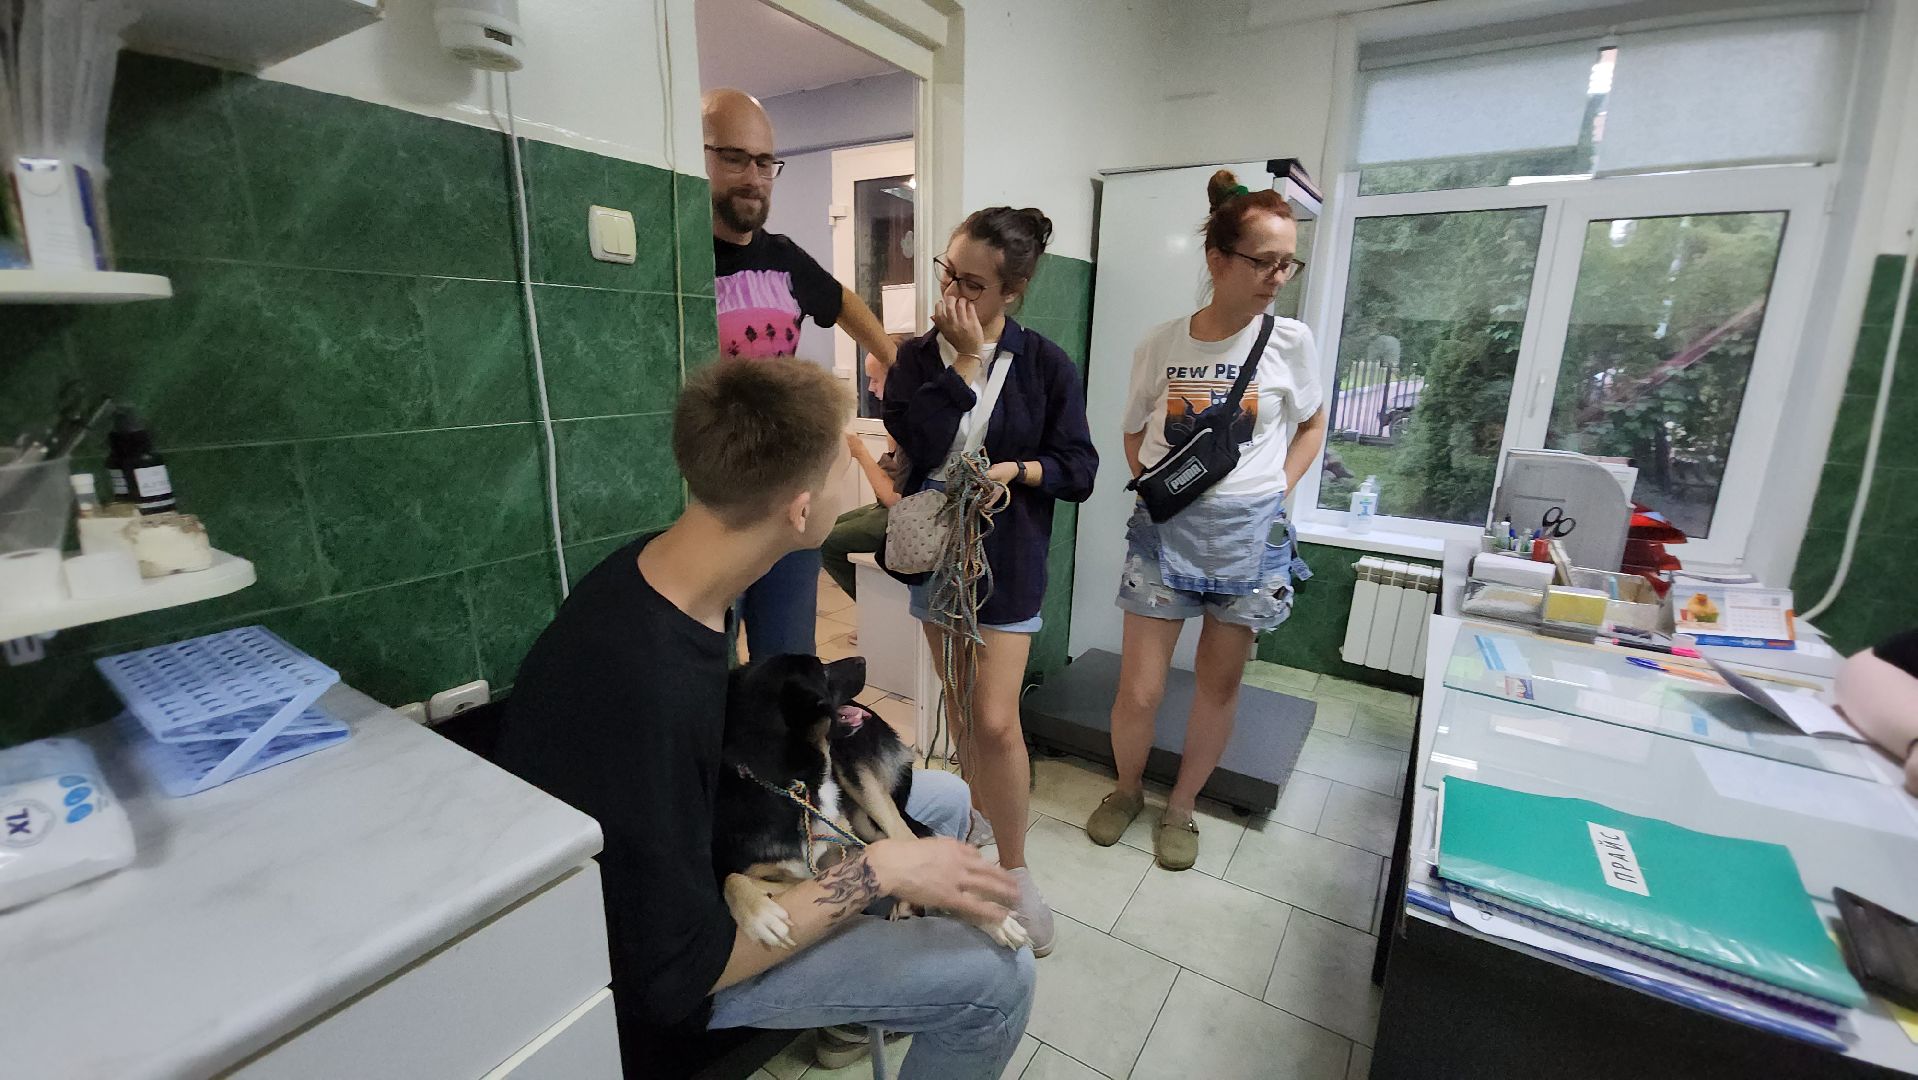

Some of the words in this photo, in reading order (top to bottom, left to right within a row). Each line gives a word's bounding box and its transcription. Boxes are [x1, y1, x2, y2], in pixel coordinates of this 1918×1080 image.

[1166, 365, 1208, 379] PEW
[1169, 463, 1202, 490] PUMA
[5, 807, 31, 835] XL
[1597, 831, 1638, 884] ПРАЙС
